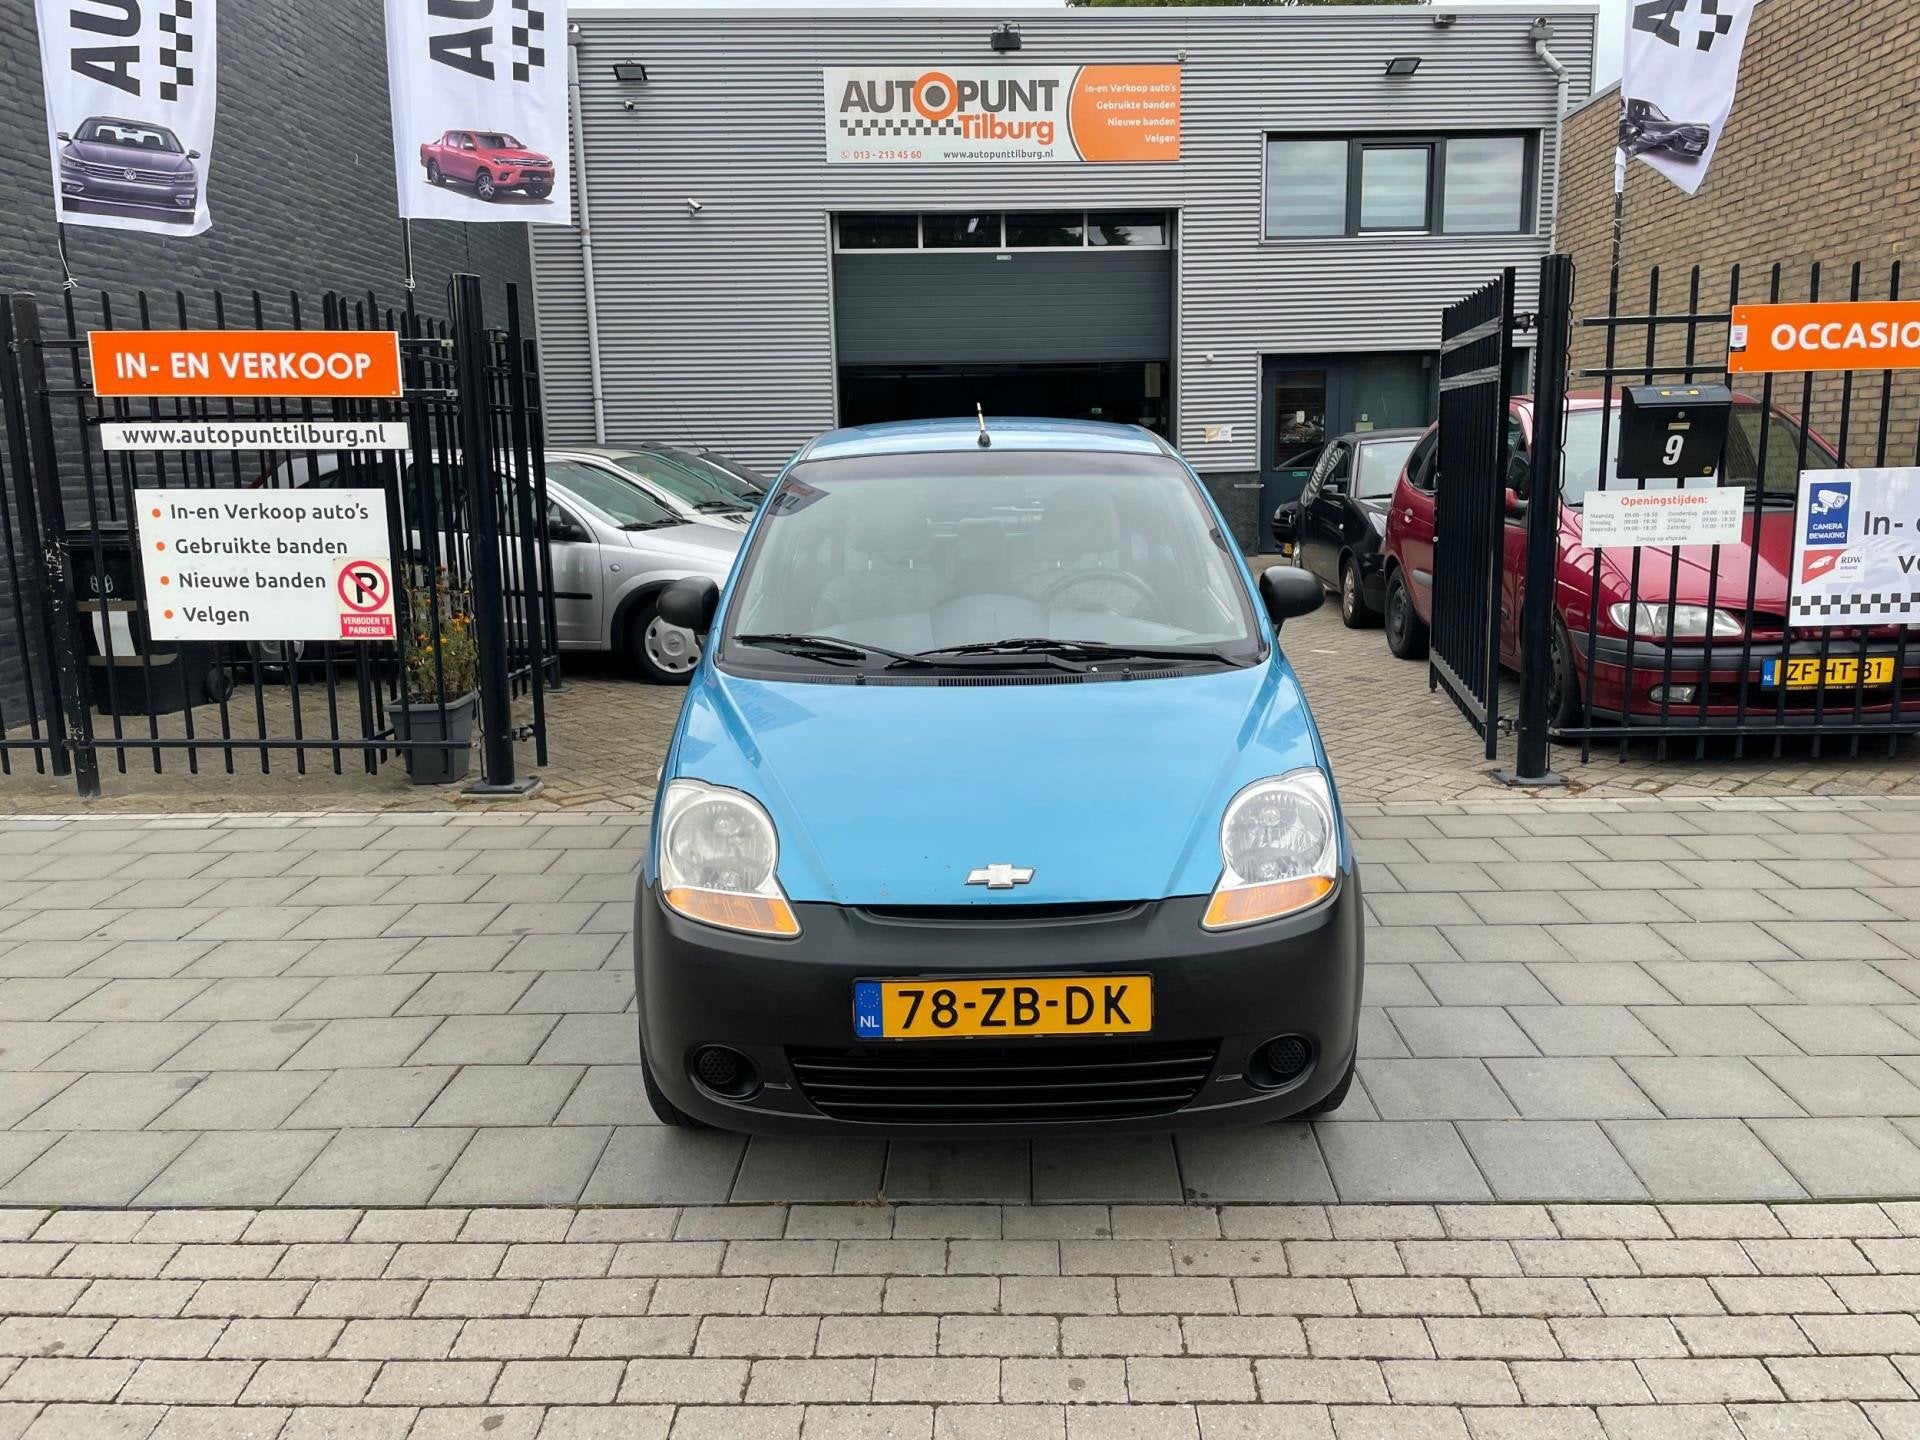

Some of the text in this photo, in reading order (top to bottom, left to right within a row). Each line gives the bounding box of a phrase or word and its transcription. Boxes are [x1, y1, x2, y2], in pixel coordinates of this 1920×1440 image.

[1085, 83, 1176, 94] In-en Verkoop auto's
[839, 71, 1060, 121] AUTOPUNT
[1096, 100, 1176, 110] Gebruikte banden
[1108, 116, 1176, 126] Nieuwe banden
[958, 114, 1054, 146] Tilburg
[1144, 134, 1176, 144] Velgen
[853, 151, 870, 160] 013
[878, 150, 896, 160] 213
[898, 150, 909, 159] 45
[910, 150, 922, 159] 60
[944, 149, 1054, 161] www.autopunttilburg.nl
[1770, 321, 1920, 351] OCCASIO
[115, 352, 372, 380] IN- EN VERKOOP
[122, 424, 387, 448] www.autopunttilburg.nl
[1662, 434, 1684, 466] 9
[1620, 495, 1708, 508] Openingstijden:
[171, 502, 369, 522] In-en Verkoop auto's
[1863, 511, 1904, 536] In-
[1809, 532, 1846, 540] BEWAKING
[175, 538, 348, 554] Gebruikte banden
[1840, 556, 1863, 564] RDW
[179, 572, 326, 588] Nieuwe banden
[182, 606, 250, 626] Velgen
[342, 616, 391, 625] VERBODEN TE
[348, 626, 386, 634] PARKEREN
[898, 984, 1132, 1030] 78-ZB-DK
[860, 1016, 880, 1028] NL
